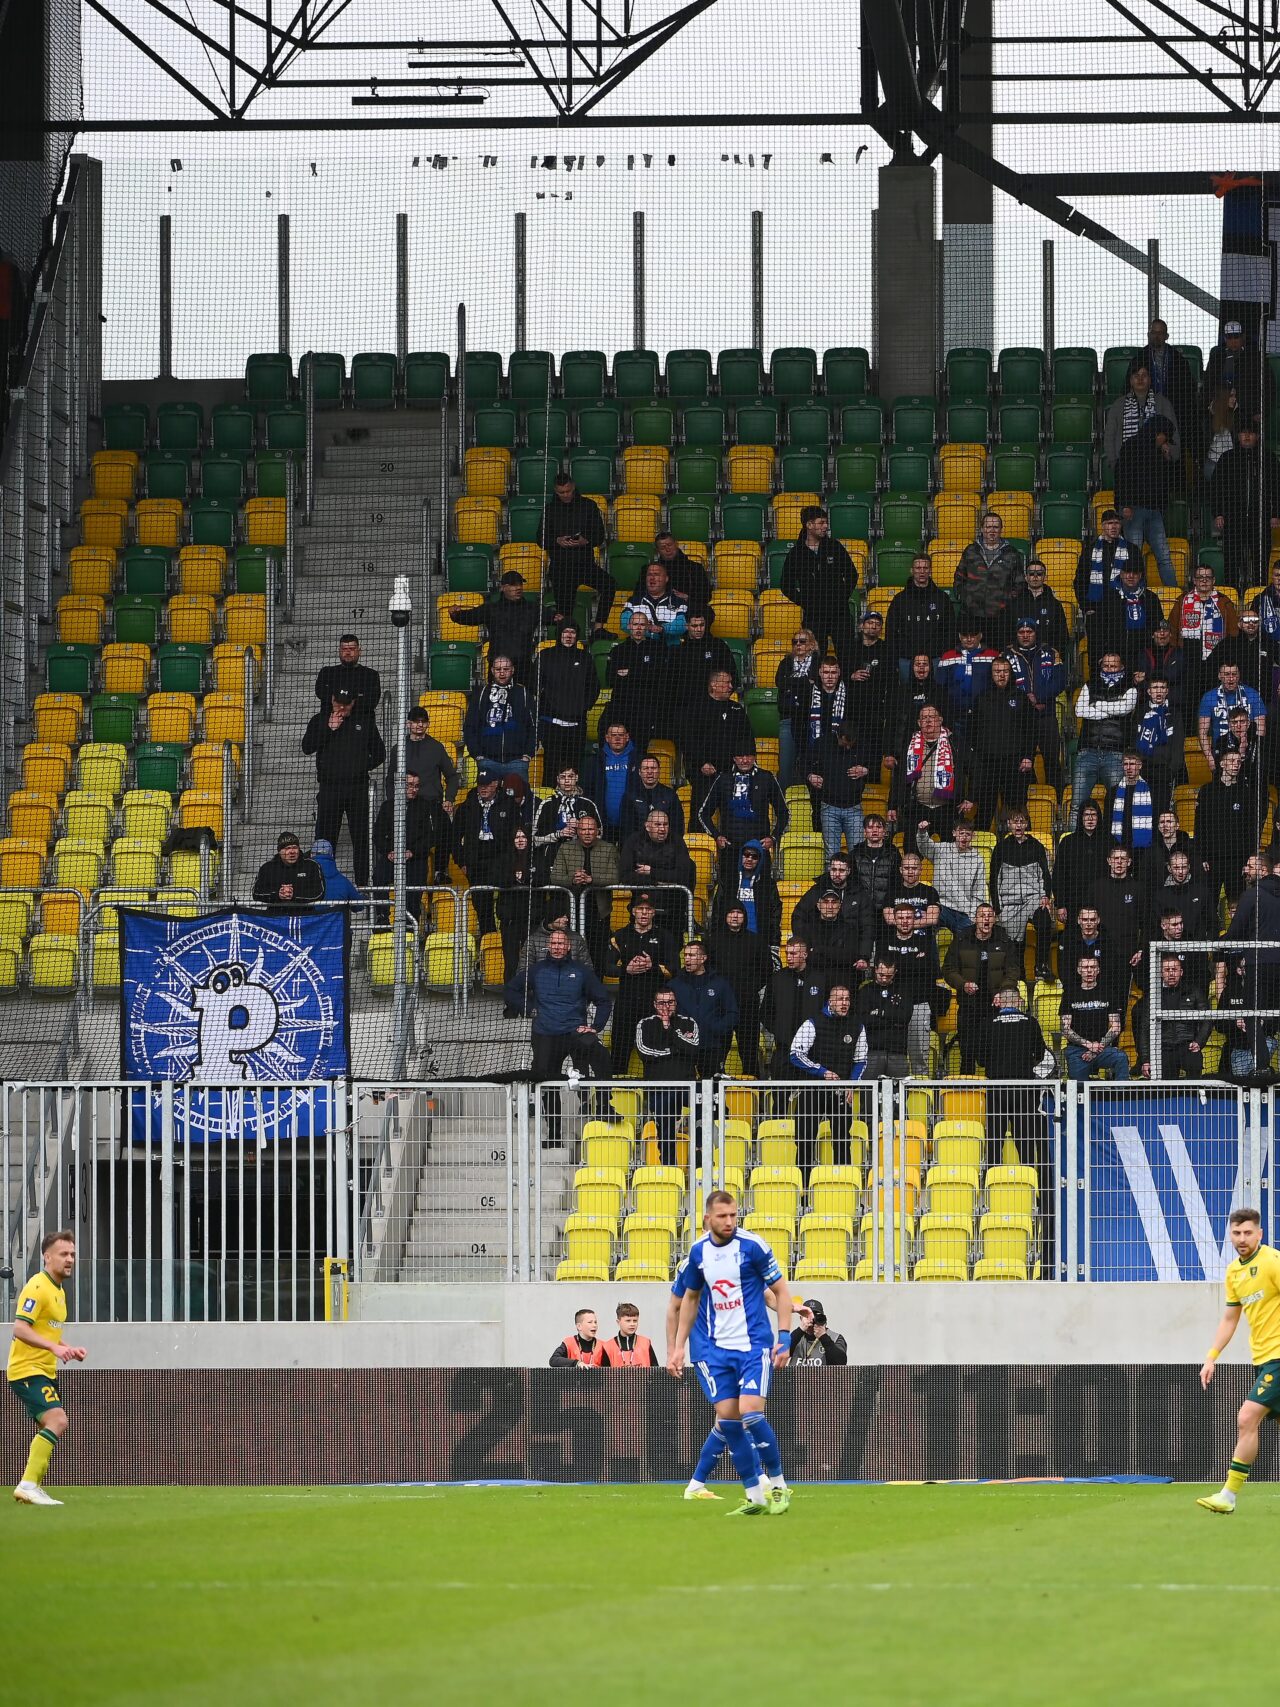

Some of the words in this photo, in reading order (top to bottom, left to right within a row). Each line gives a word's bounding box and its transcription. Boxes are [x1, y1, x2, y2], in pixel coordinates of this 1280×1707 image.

[380, 462, 395, 473] 20
[370, 513, 384, 523] 19
[361, 562, 375, 573] 18
[351, 608, 366, 619] 17
[490, 1150, 506, 1161] 06
[480, 1196, 496, 1207] 05
[471, 1243, 487, 1254] 04
[450, 1367, 807, 1479] 25.0
